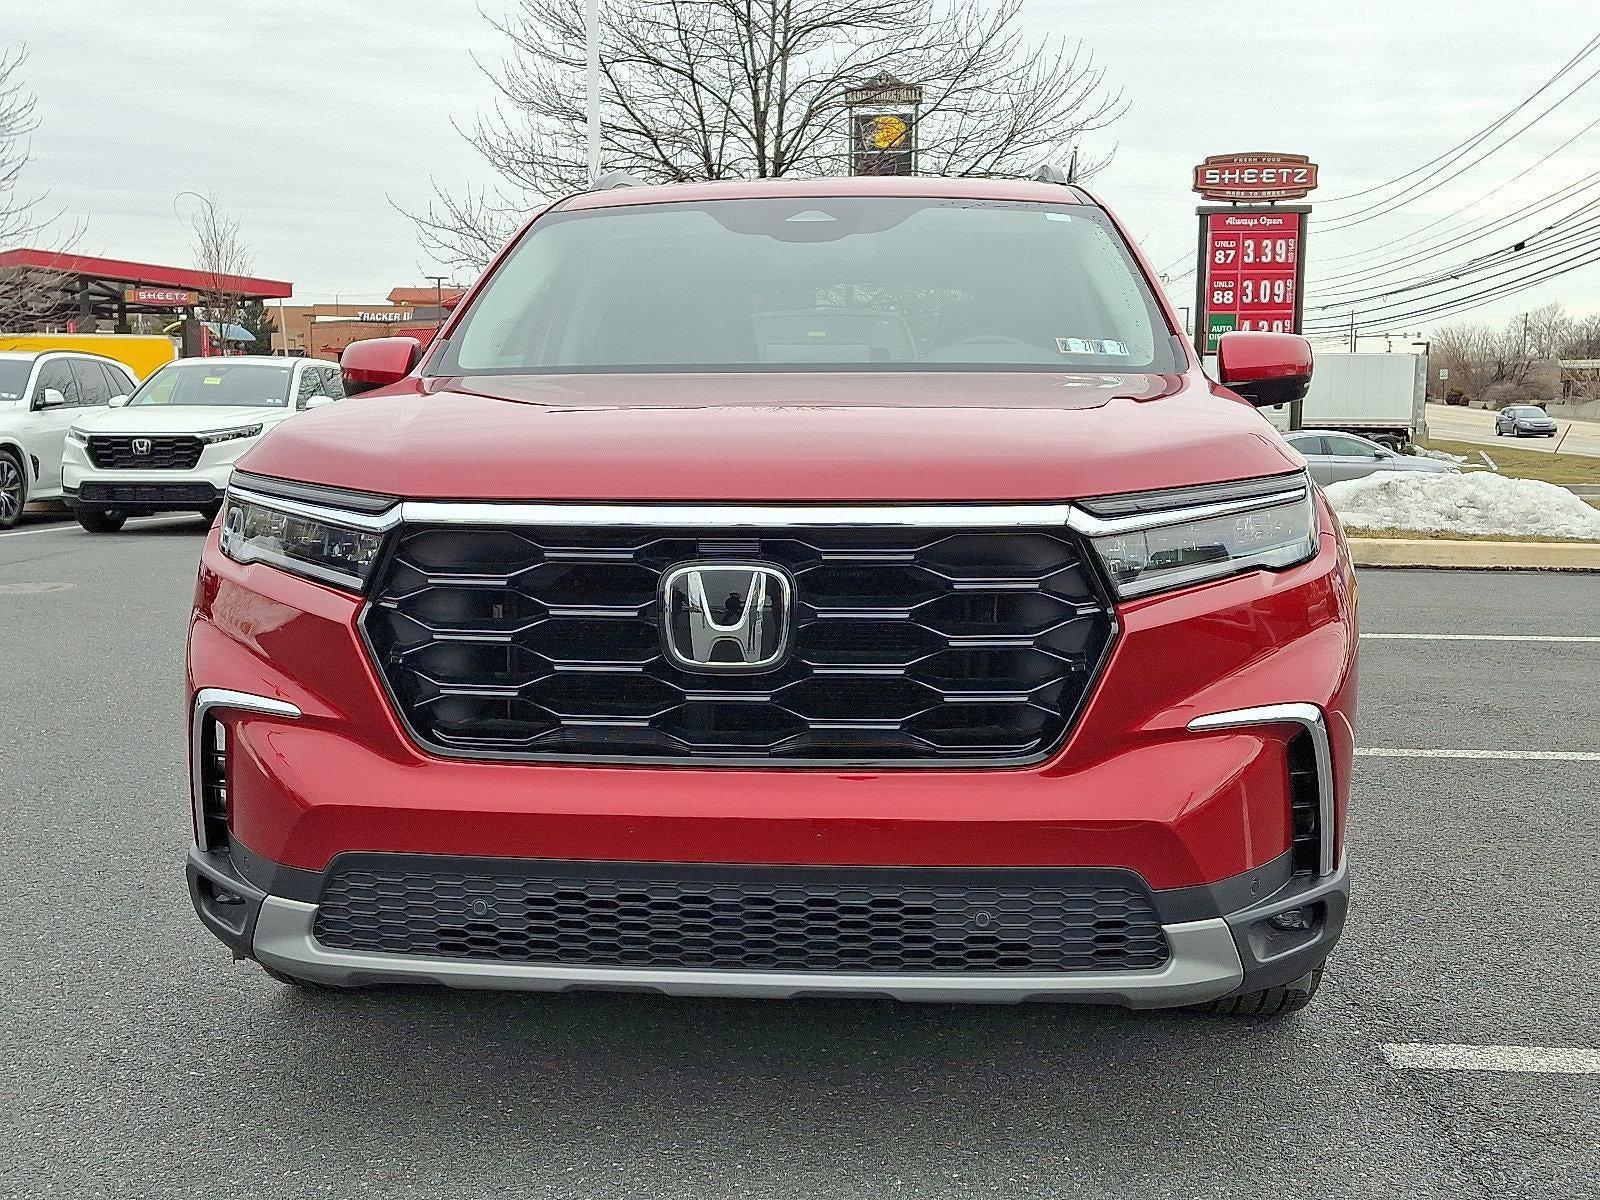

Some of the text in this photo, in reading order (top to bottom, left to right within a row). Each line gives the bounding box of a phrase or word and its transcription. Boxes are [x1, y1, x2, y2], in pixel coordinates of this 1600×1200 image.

[1205, 168, 1308, 184] SHEETZ
[1226, 216, 1283, 227] Always Open
[1215, 240, 1236, 248] UNLD
[1214, 249, 1236, 264] 87
[139, 291, 187, 301] SHEETZ
[1213, 290, 1234, 304] 88
[357, 311, 400, 322] TRACKER
[1211, 325, 1232, 333] AUTO
